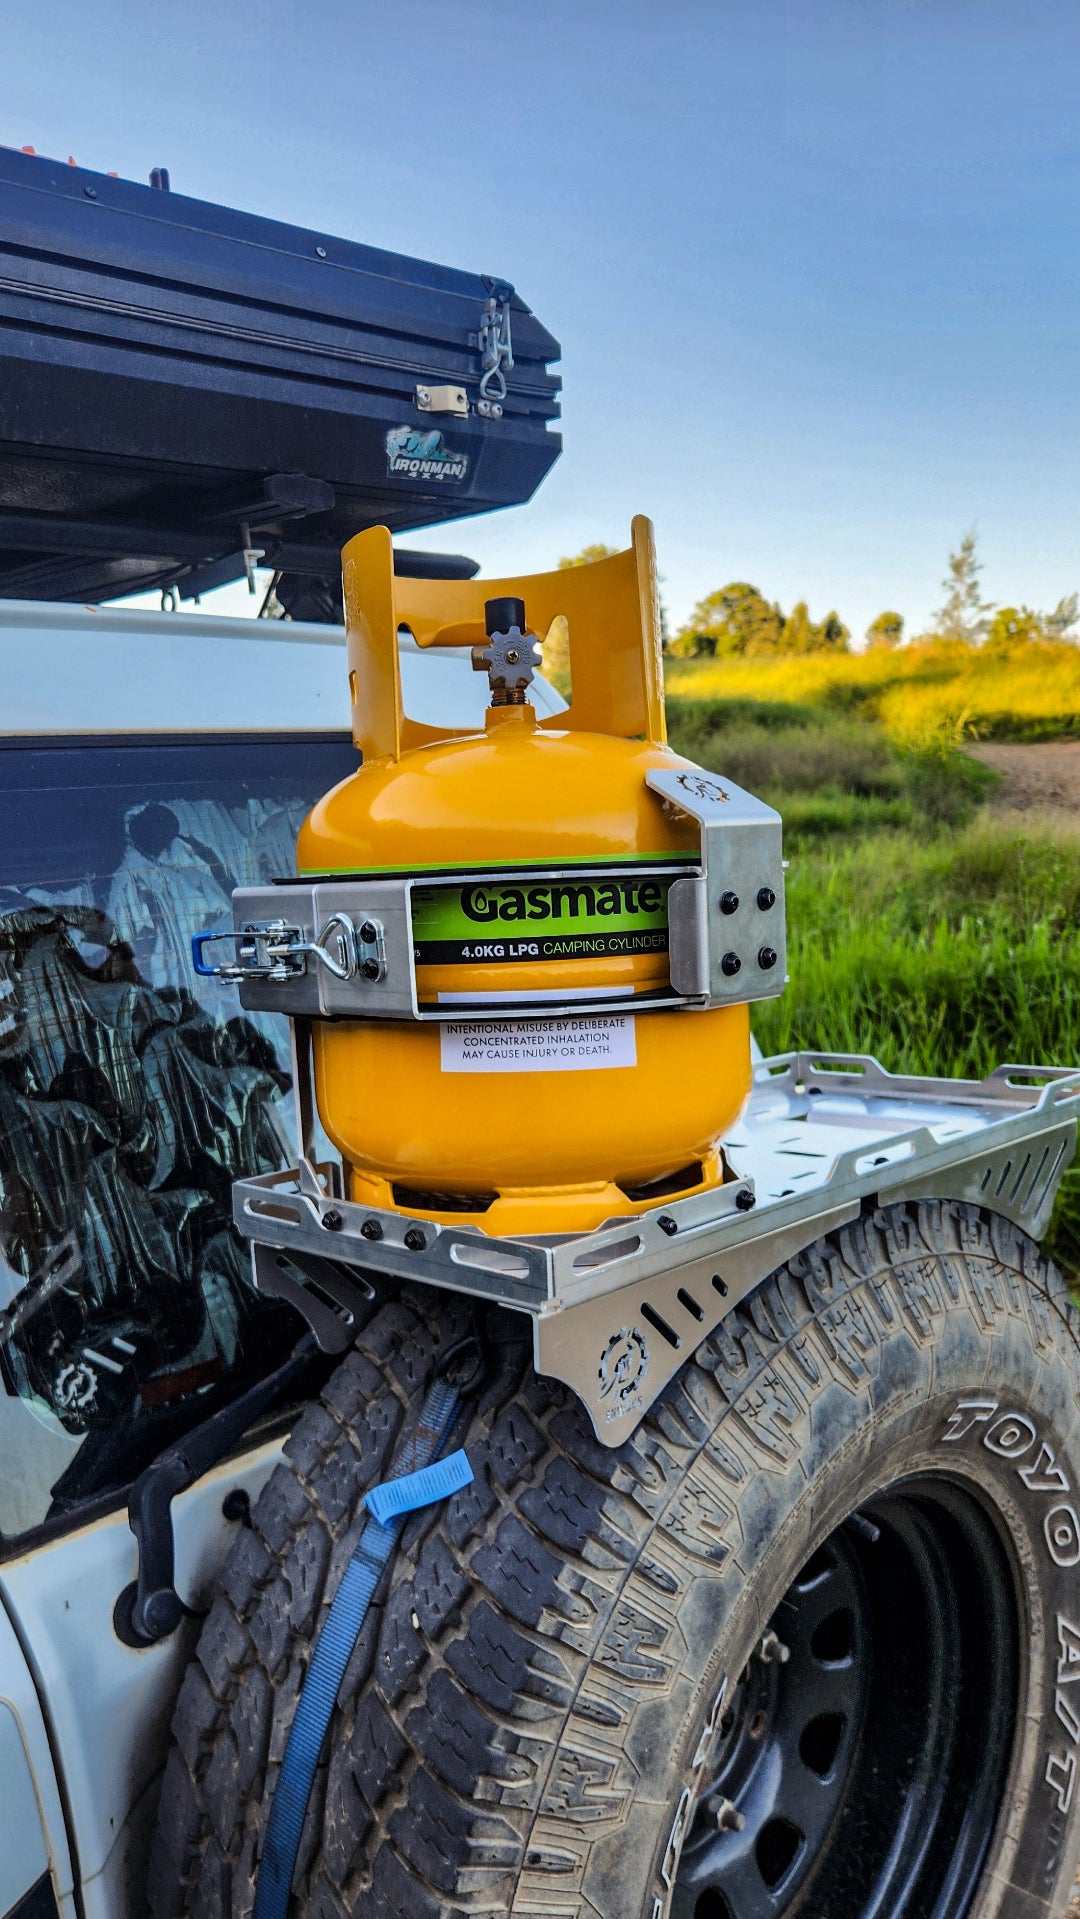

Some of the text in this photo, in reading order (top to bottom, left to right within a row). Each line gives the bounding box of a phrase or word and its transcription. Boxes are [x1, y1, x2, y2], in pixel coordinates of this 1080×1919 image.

[395, 459, 462, 476] IRONMAN
[461, 882, 663, 923] Gasmate
[461, 934, 666, 958] 4.0KG LPG CAMPING CYLINDER
[447, 1018, 626, 1034] INTENTIONAL MISUSE BY DELIBERATE
[463, 1032, 610, 1047] CONCENTRATED INHALATION
[462, 1045, 613, 1060] MAY CAUSE INJURY OR DEATH.
[941, 1402, 1080, 1567] TOYO
